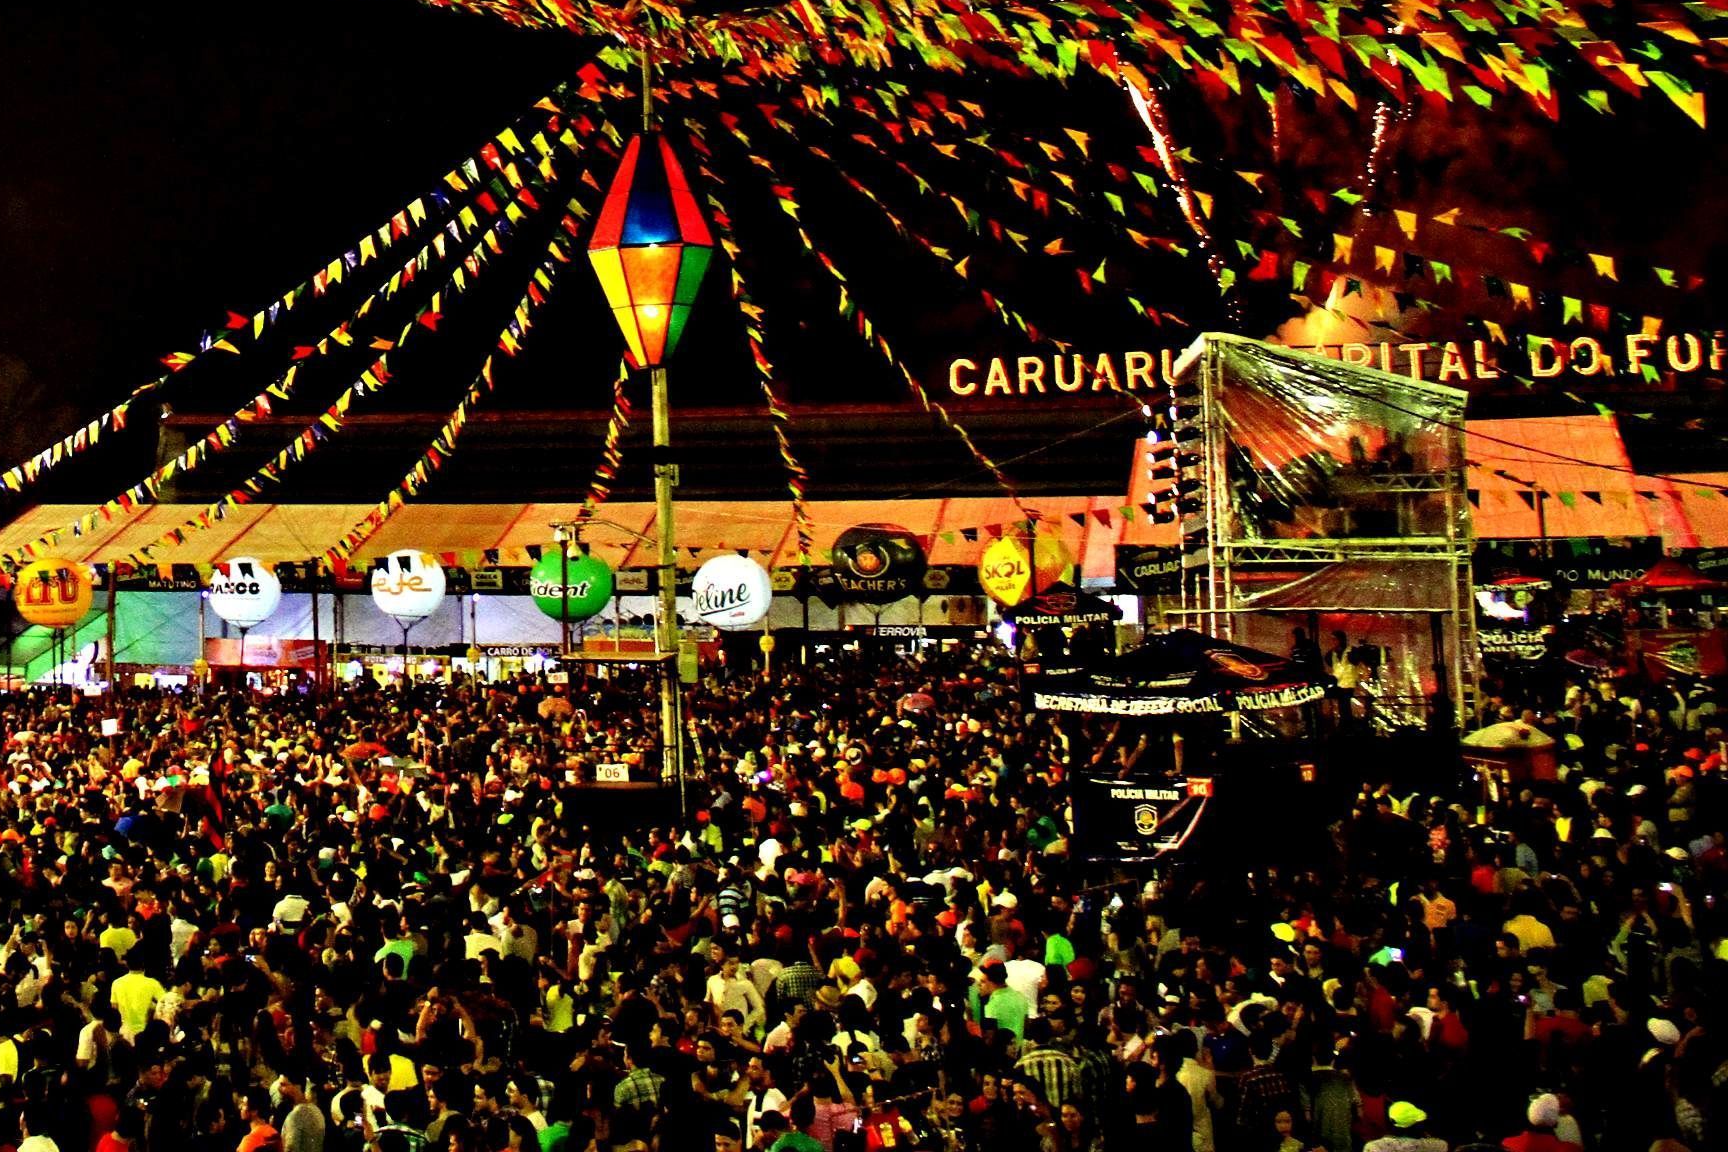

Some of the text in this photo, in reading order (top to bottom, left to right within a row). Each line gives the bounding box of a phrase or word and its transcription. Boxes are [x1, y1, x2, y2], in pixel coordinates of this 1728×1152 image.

[984, 560, 1025, 580] SKOL
[834, 572, 907, 591] TEACHER'S
[1063, 612, 1109, 623] MILITAR
[487, 647, 520, 656] CARRO
[1176, 696, 1224, 714] SOCIAL
[605, 767, 620, 778] 06
